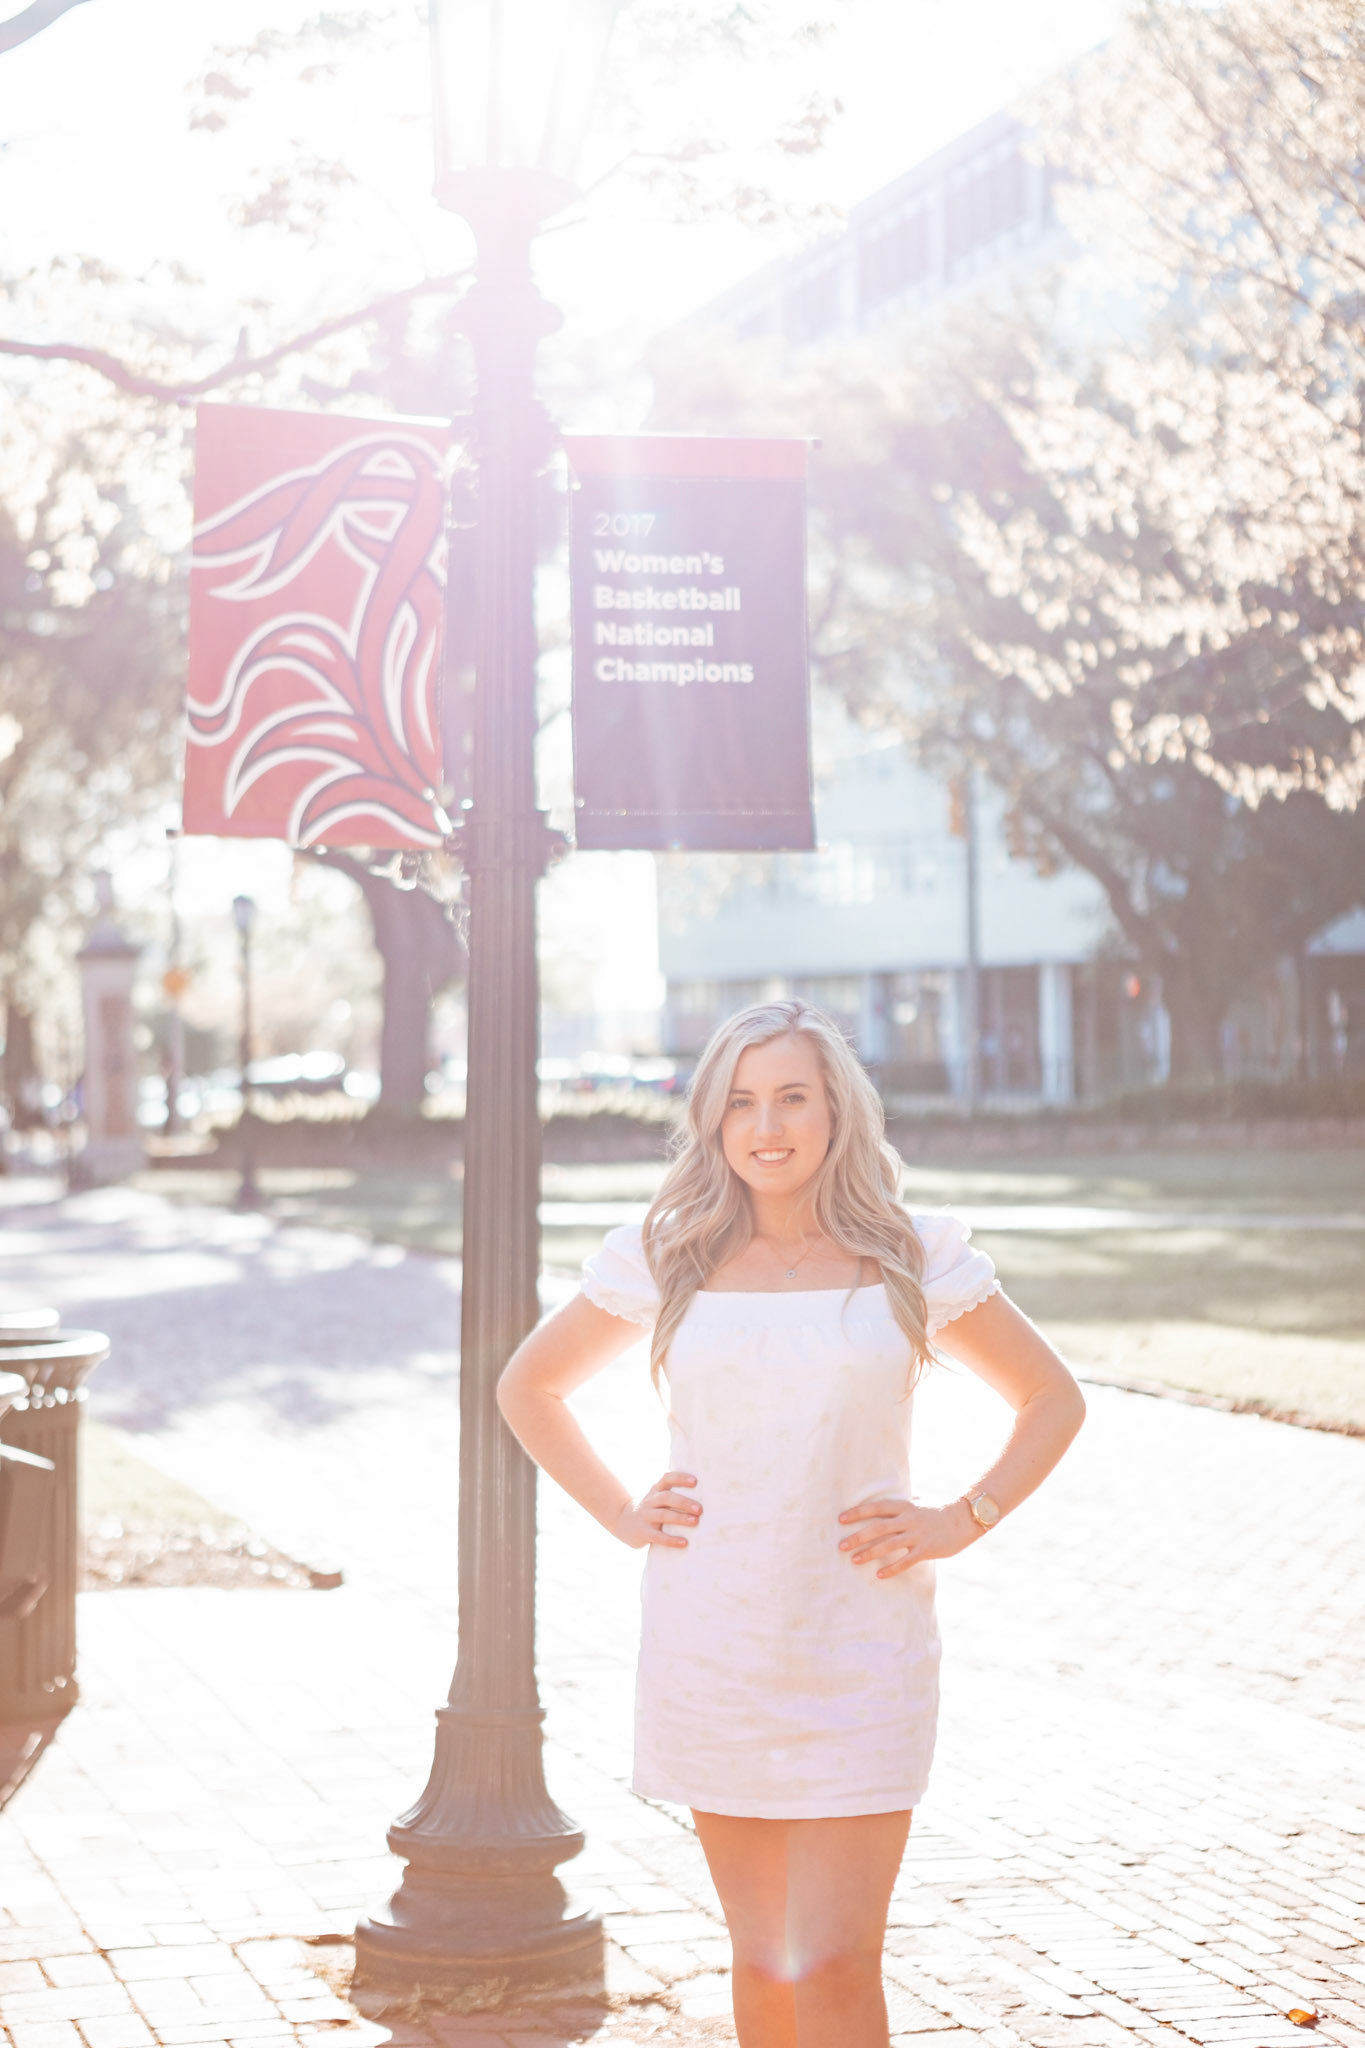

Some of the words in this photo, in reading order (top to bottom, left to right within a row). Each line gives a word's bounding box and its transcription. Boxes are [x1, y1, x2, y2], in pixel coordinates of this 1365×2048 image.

[594, 513, 656, 536] 2017
[595, 549, 725, 575] Women's
[595, 585, 741, 611] Basketball
[595, 622, 714, 647] National
[596, 657, 754, 687] Champions
